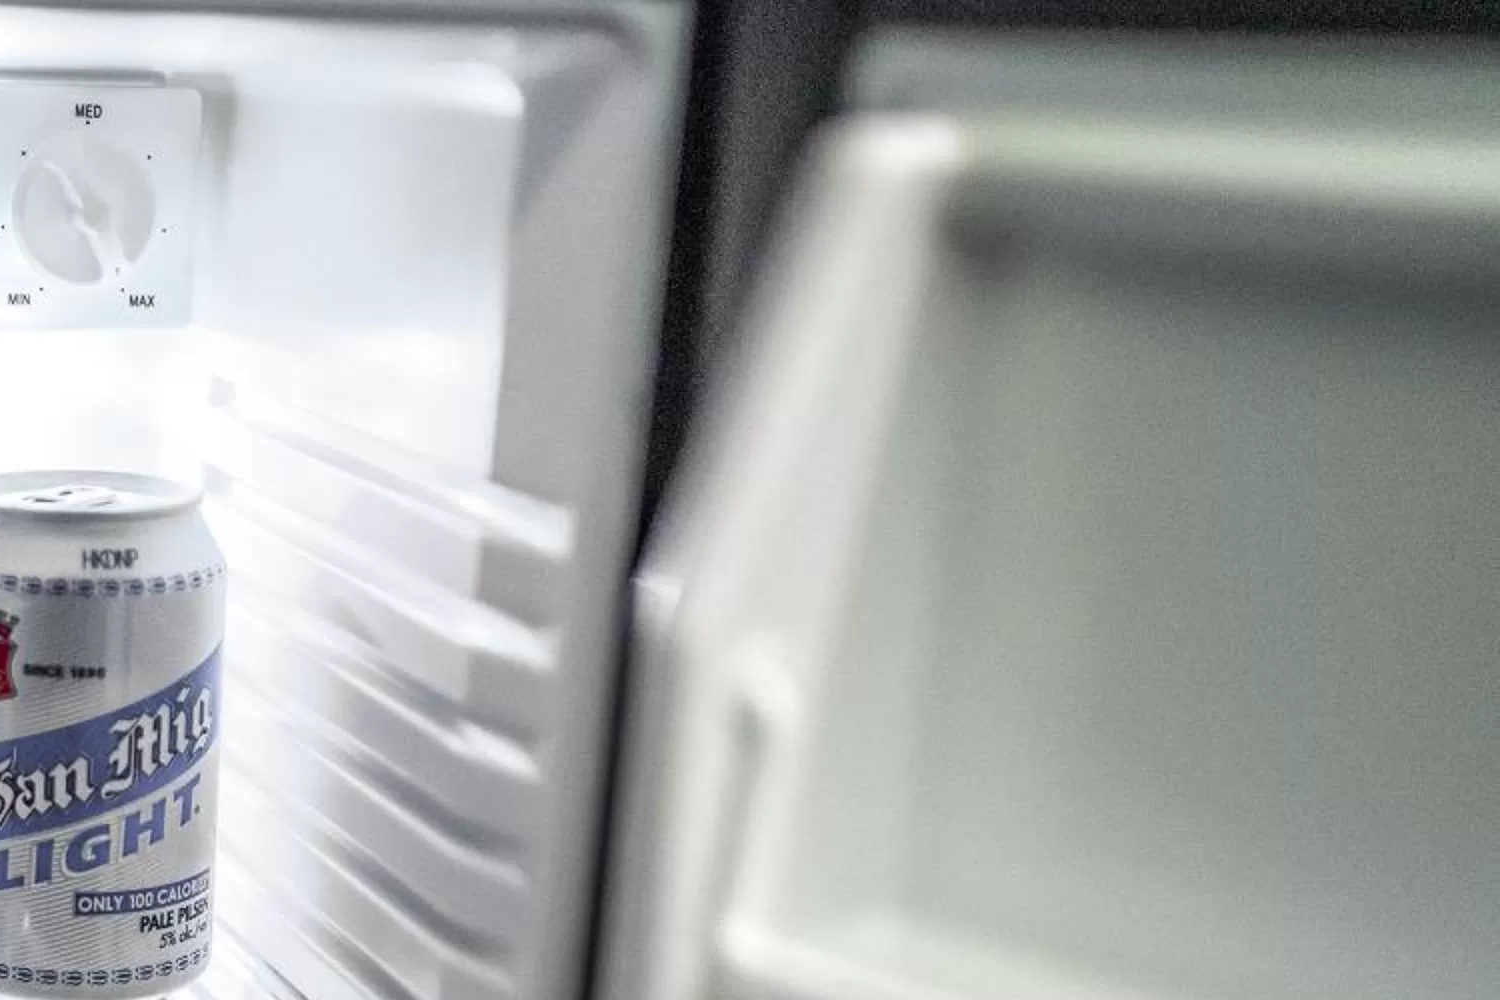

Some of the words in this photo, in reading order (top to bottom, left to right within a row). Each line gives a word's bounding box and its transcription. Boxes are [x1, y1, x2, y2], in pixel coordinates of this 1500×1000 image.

[75, 104, 102, 118] MED
[8, 293, 31, 305] MIN
[129, 295, 155, 307] MAX
[78, 894, 124, 913] ONLY
[129, 890, 155, 909] 100
[140, 910, 175, 933] PALE
